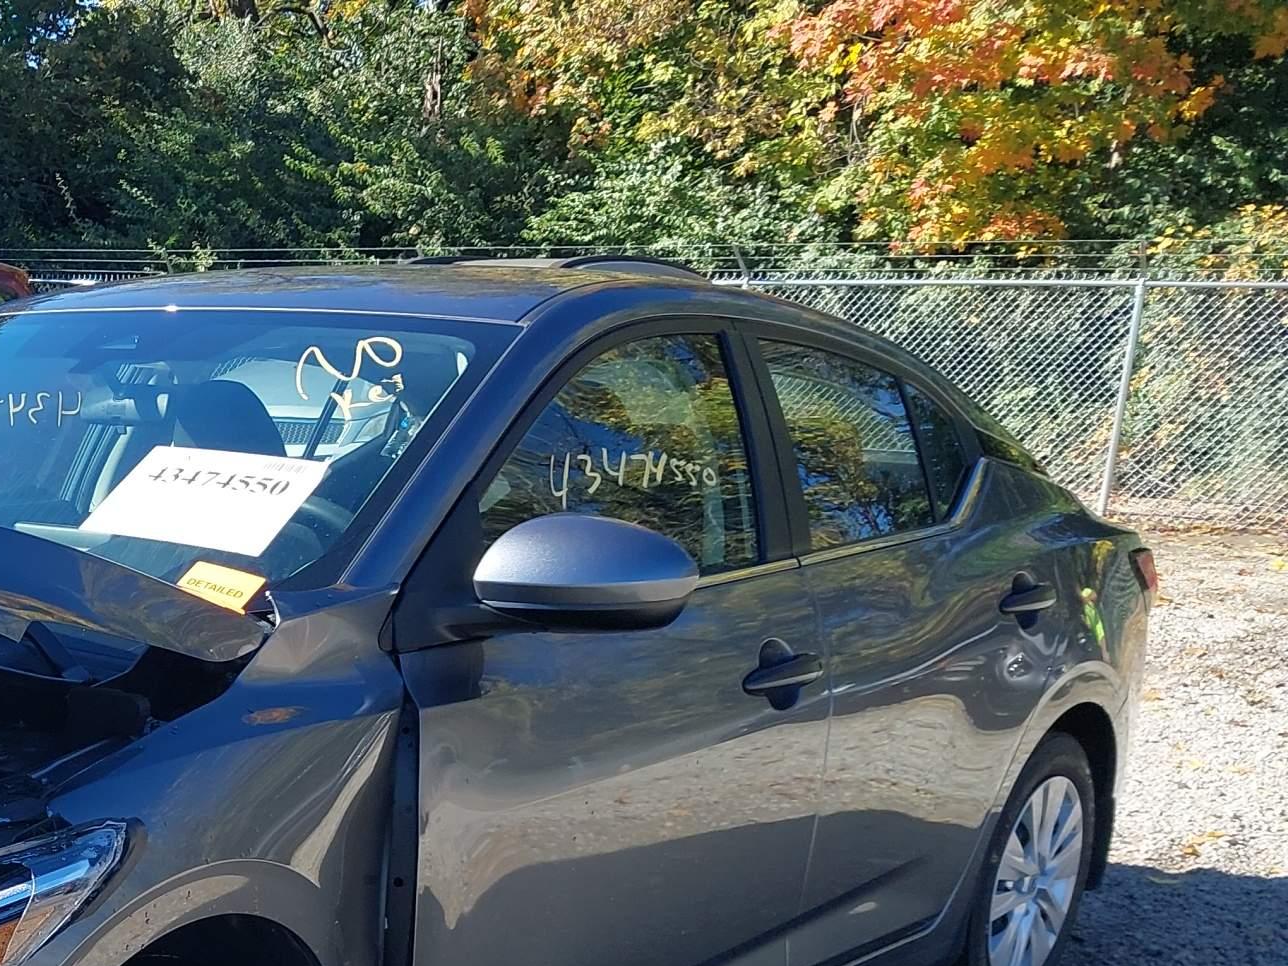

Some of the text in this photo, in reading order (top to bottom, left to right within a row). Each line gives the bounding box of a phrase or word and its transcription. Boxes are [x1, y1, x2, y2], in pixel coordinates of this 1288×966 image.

[148, 466, 291, 496] 43474550
[549, 447, 717, 509] 43474550
[186, 577, 244, 599] DETAILED
